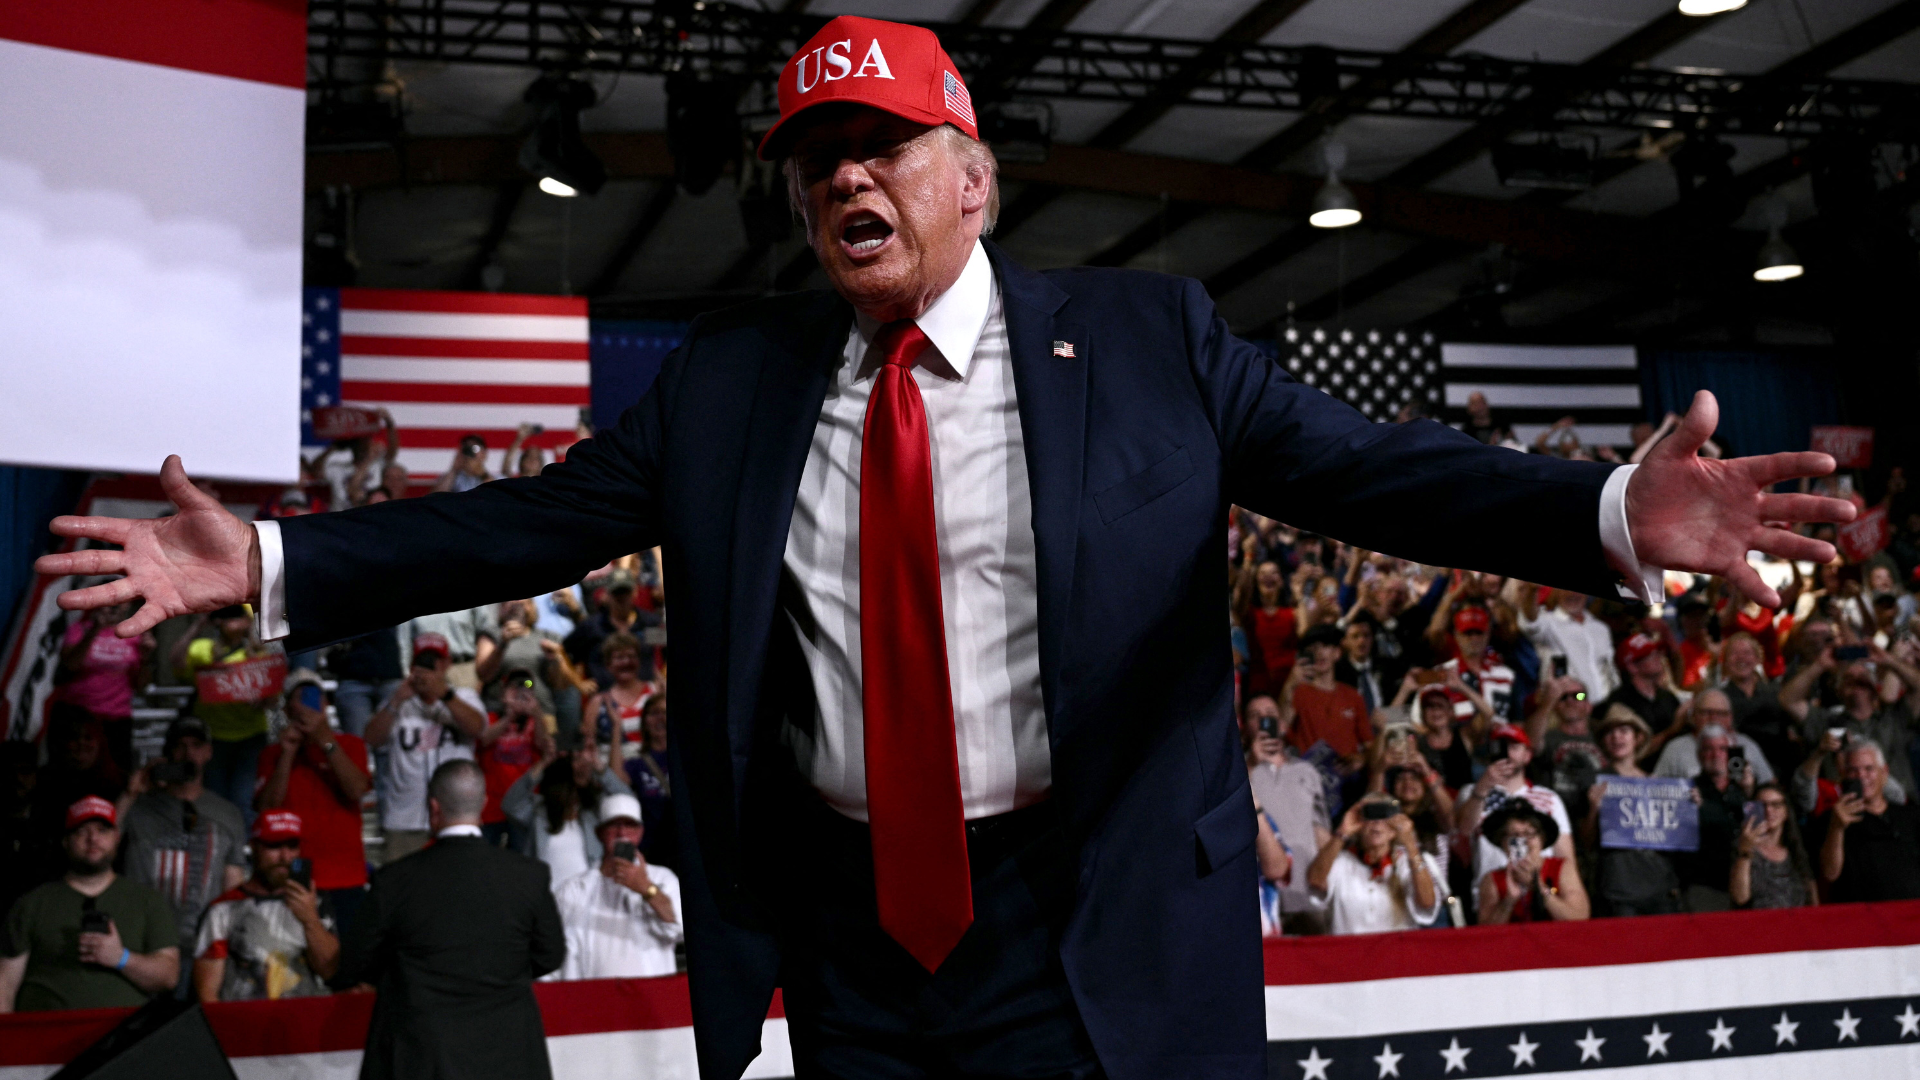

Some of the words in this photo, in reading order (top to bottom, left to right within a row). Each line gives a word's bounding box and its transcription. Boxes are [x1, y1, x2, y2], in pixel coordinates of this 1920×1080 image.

[796, 38, 895, 94] USA
[214, 665, 272, 695] SAFE
[1619, 797, 1679, 829] SAFE
